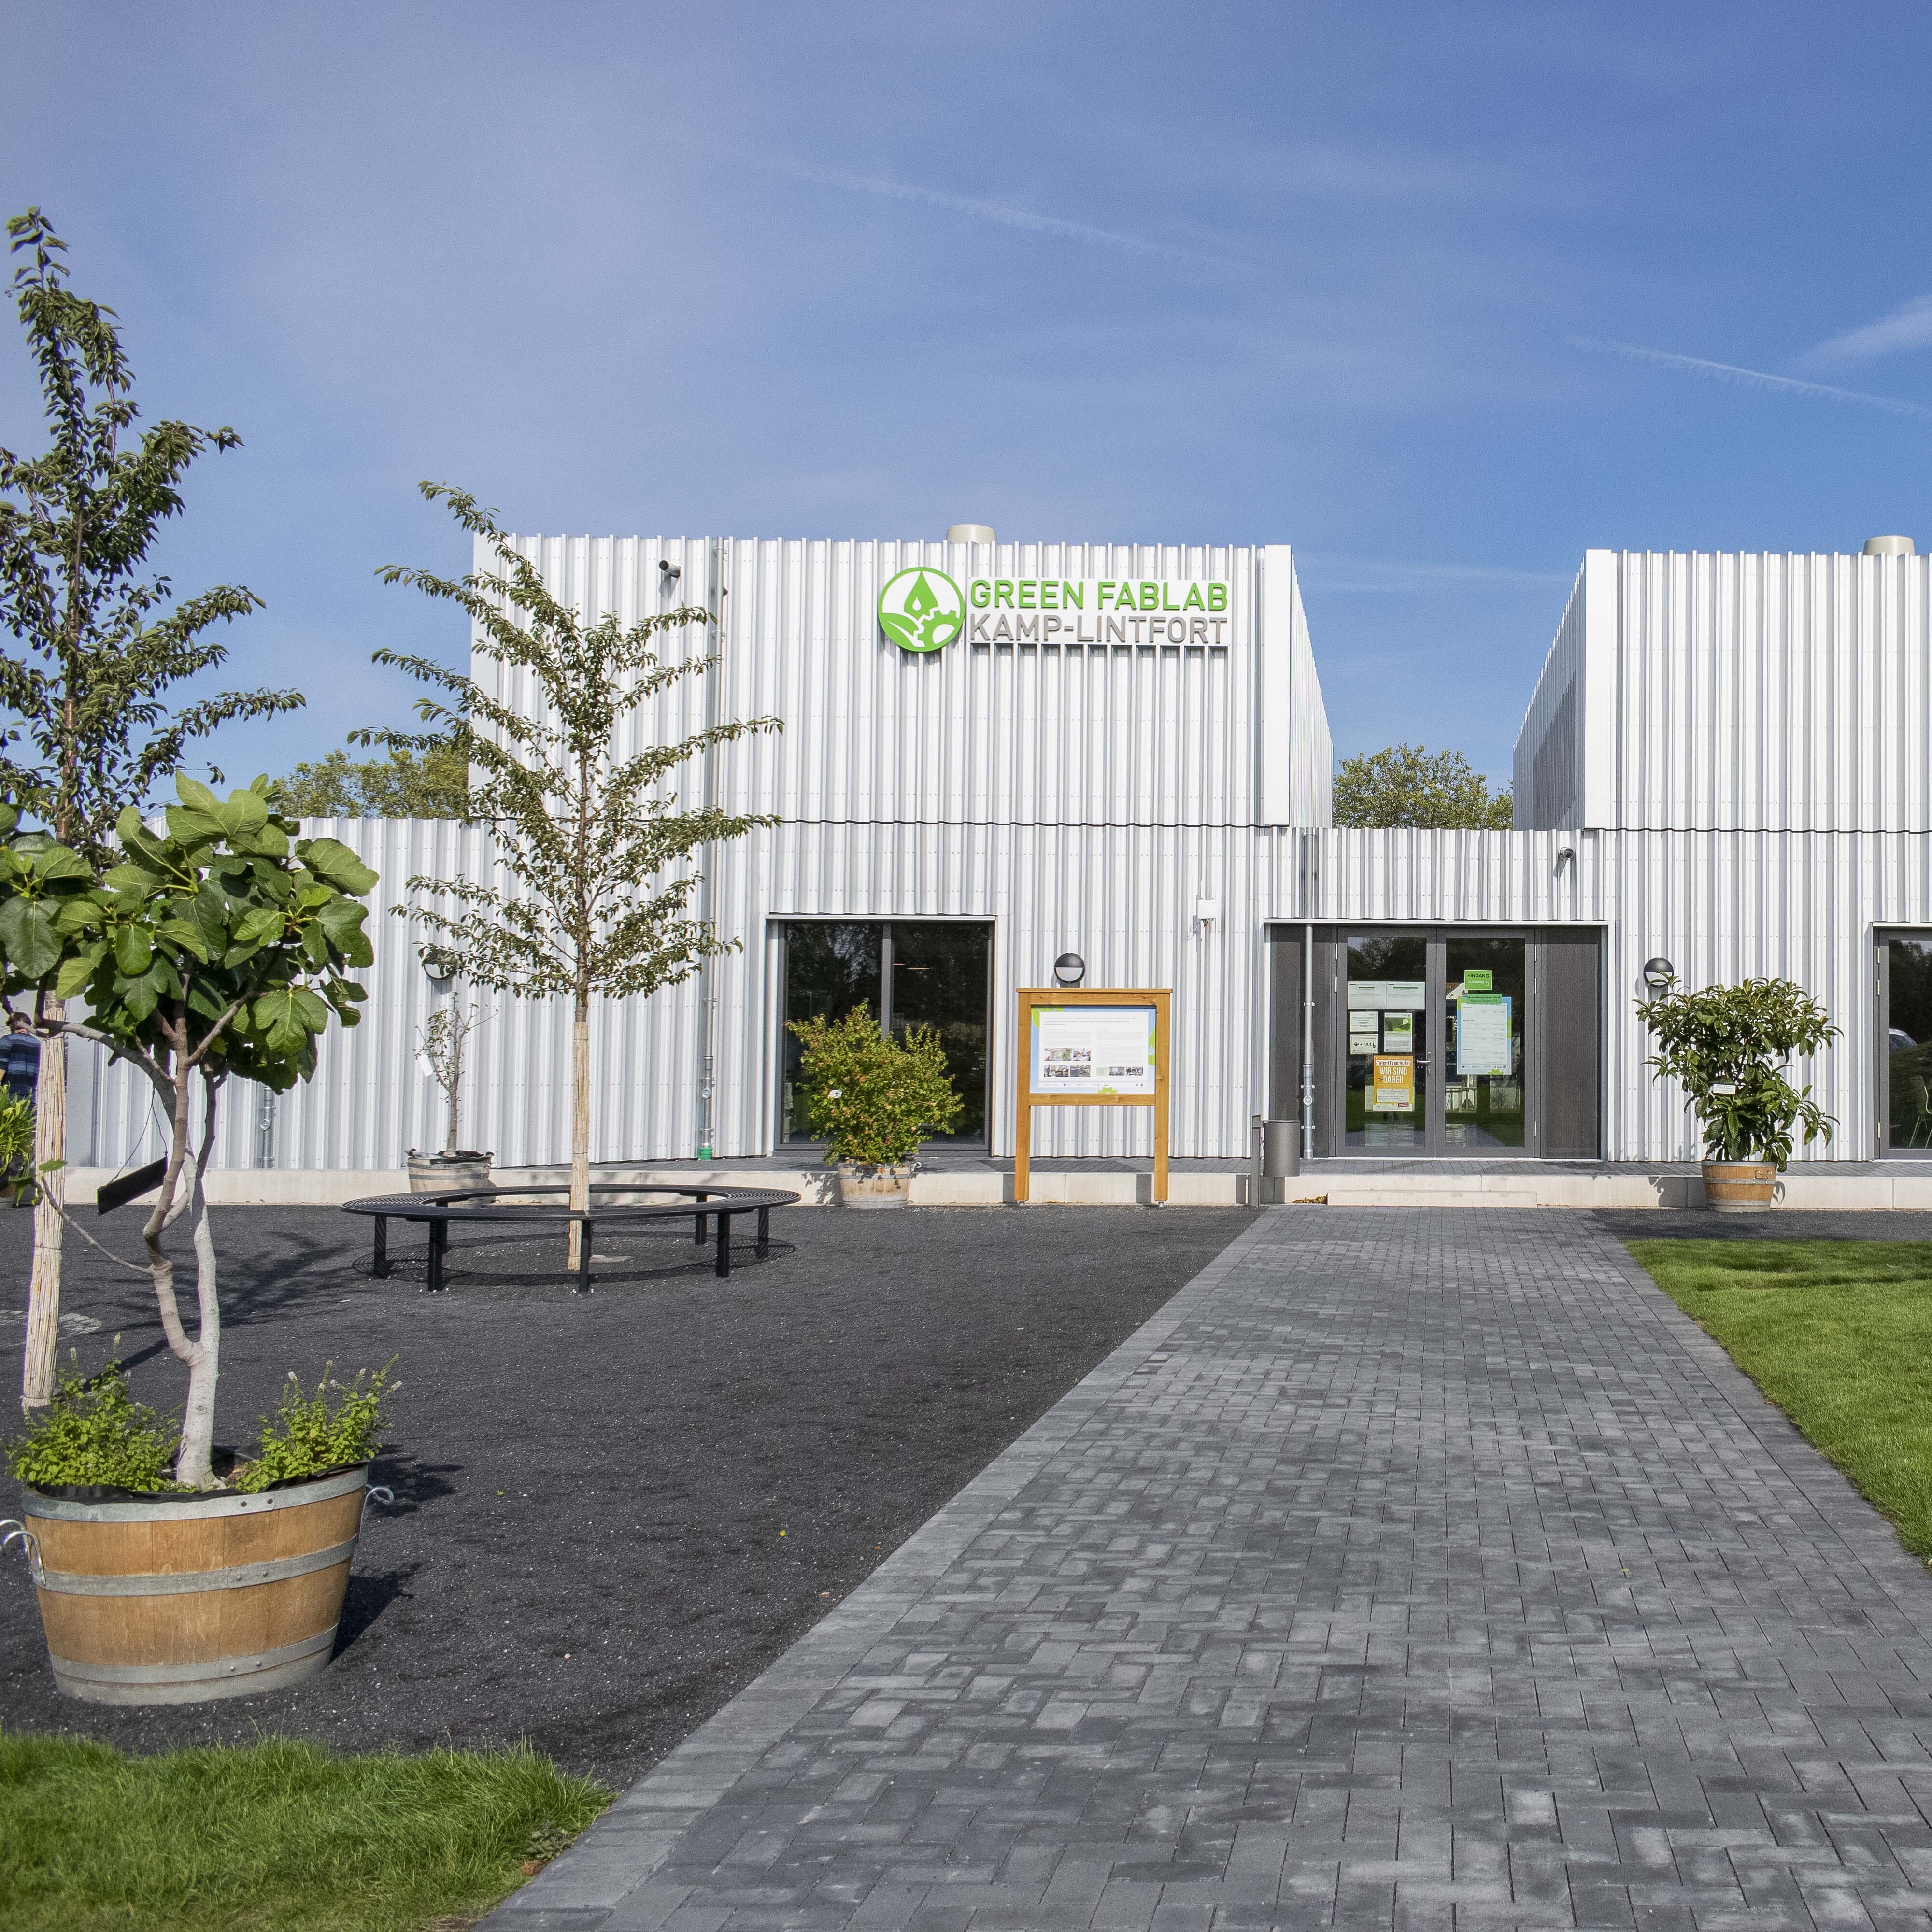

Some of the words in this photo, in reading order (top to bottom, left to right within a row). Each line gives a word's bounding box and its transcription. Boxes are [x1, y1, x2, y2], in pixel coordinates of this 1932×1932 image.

[971, 580, 1083, 609] GREEN
[1098, 582, 1227, 610] FABLAB
[970, 613, 1227, 643] KAMP-LINTFORT
[1379, 1066, 1391, 1075] WIR
[1393, 1066, 1407, 1075] SIND
[1383, 1075, 1404, 1083] DABEI!
